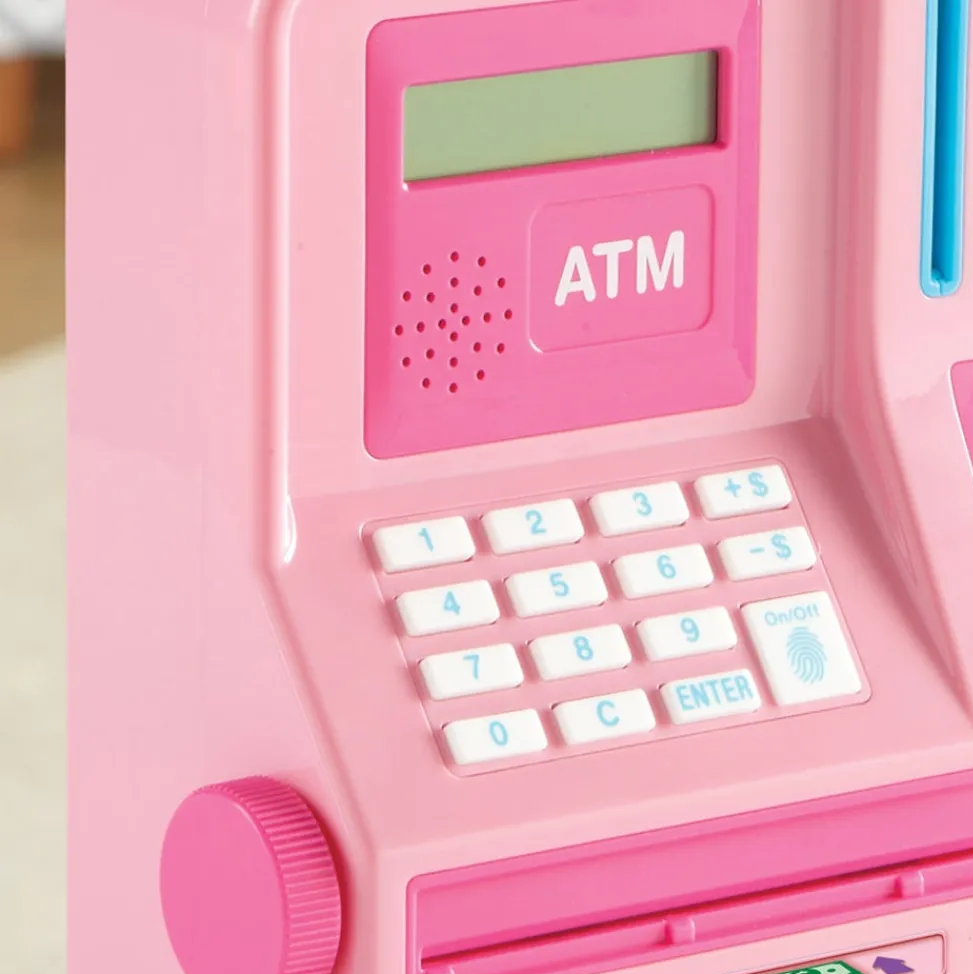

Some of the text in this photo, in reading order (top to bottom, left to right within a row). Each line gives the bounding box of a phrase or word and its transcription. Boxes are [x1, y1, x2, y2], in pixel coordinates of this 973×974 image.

[554, 230, 685, 307] ATM
[418, 527, 434, 552] 1
[525, 509, 547, 535] 2
[631, 491, 653, 518] 3
[442, 590, 462, 615] 4
[549, 571, 570, 598] 5
[656, 553, 677, 580] 6
[764, 603, 820, 628] On/Off
[463, 617, 701, 681] 7 8 9
[488, 674, 754, 748] 0 C ENTER
